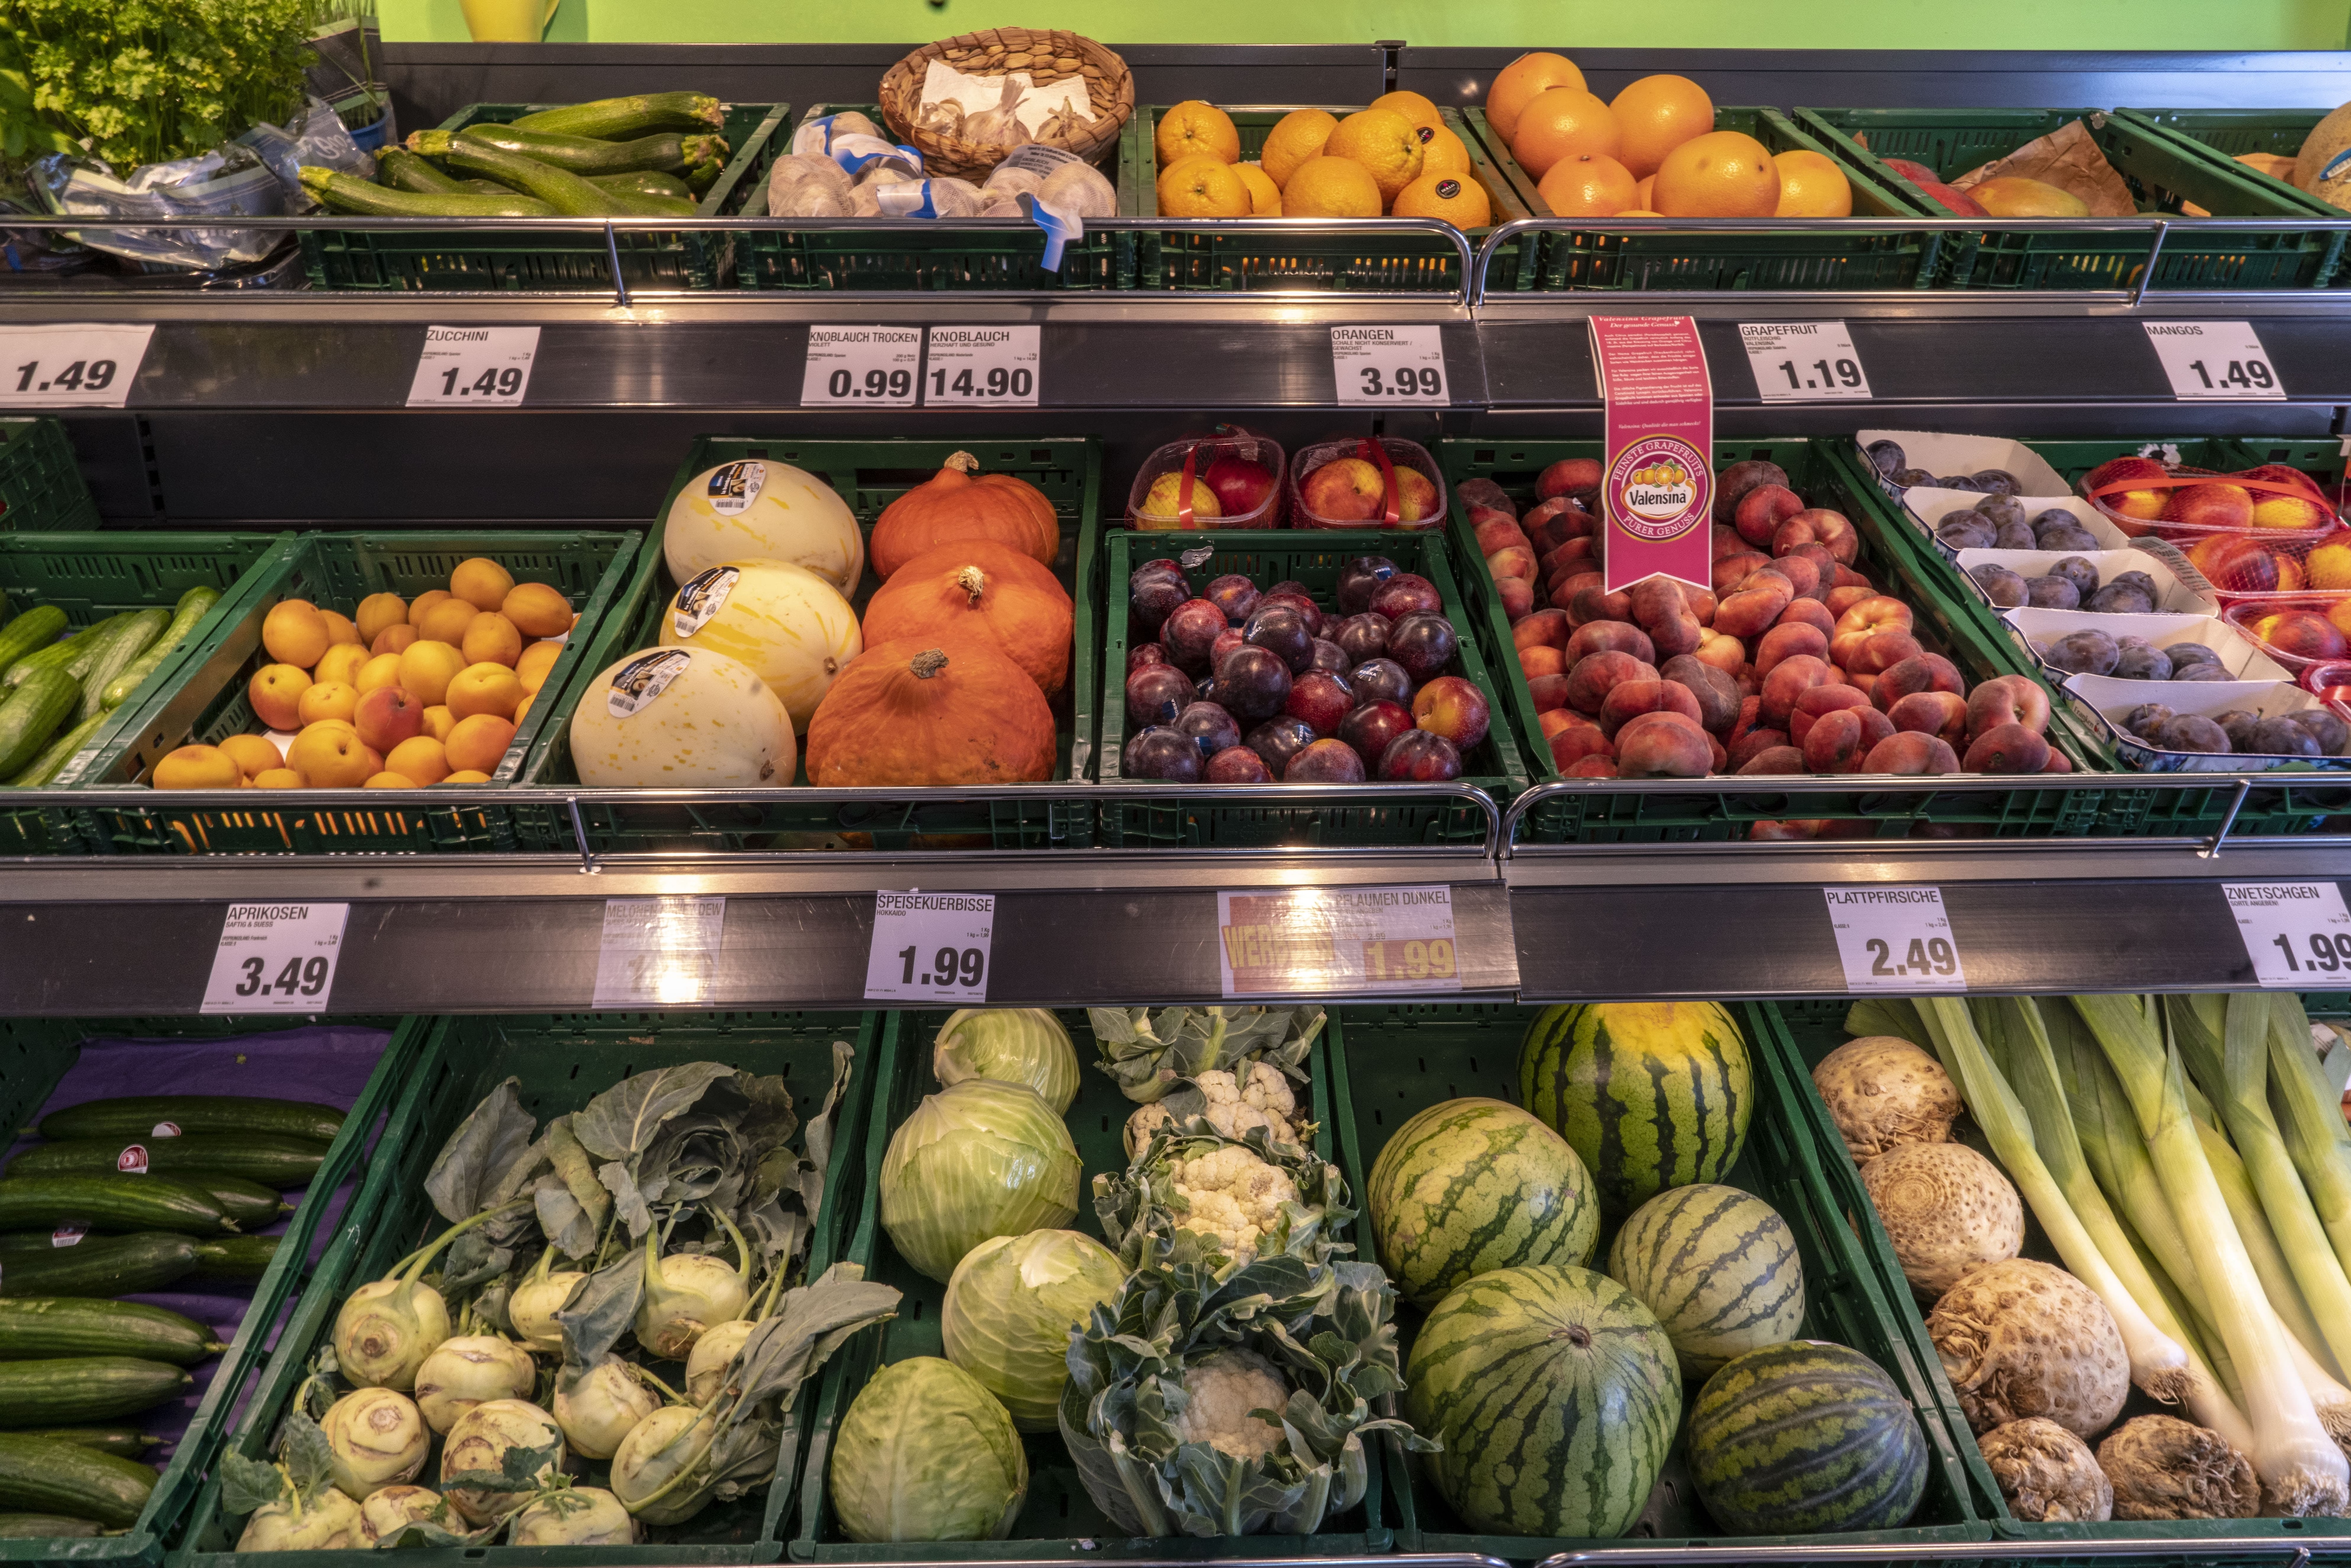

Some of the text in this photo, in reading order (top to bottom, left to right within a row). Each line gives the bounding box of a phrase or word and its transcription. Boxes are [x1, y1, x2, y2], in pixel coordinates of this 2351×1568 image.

[426, 330, 489, 341] ZUCCHINI
[810, 332, 917, 343] KNOBLAUCH TROCKEN
[931, 331, 1010, 342] KNOBLAUCH
[1332, 330, 1394, 340] ORANGEN
[1742, 325, 1817, 336] GRAPEFRUIT
[2146, 326, 2203, 335] MANGOS
[16, 360, 117, 392] 1.49
[442, 368, 522, 396] 1.49
[931, 368, 1033, 397] 14.90
[1360, 367, 1441, 395] 3.99
[1779, 359, 1862, 389] 1.19
[2190, 360, 2273, 388] 1.49
[828, 369, 911, 398] 0.99
[1613, 441, 1704, 481] FEINSTE GRAPEFRUITS
[1629, 489, 1686, 505] Valensina
[1623, 512, 1695, 536] PURER GENUSS
[687, 587, 701, 605] bomba
[1248, 626, 1262, 640] EDEKA
[1333, 675, 1348, 691] EDEKA
[2074, 706, 2095, 727] Franken
[1336, 890, 1450, 907] PFLAUMEN DUNKEL
[1827, 890, 1939, 904] PLATTPFIRSICHE
[2225, 886, 2320, 899] ZWETSCHGEN
[698, 903, 723, 916] DEW
[878, 895, 992, 912] SPEISEKUERBISSE
[228, 906, 308, 920] APRIKOSEN
[1367, 940, 1455, 980] 1.99
[1866, 938, 1956, 976] 2.49
[2273, 933, 2351, 971] 1.99
[899, 946, 984, 987] 1.99
[236, 956, 329, 996] 3.49
